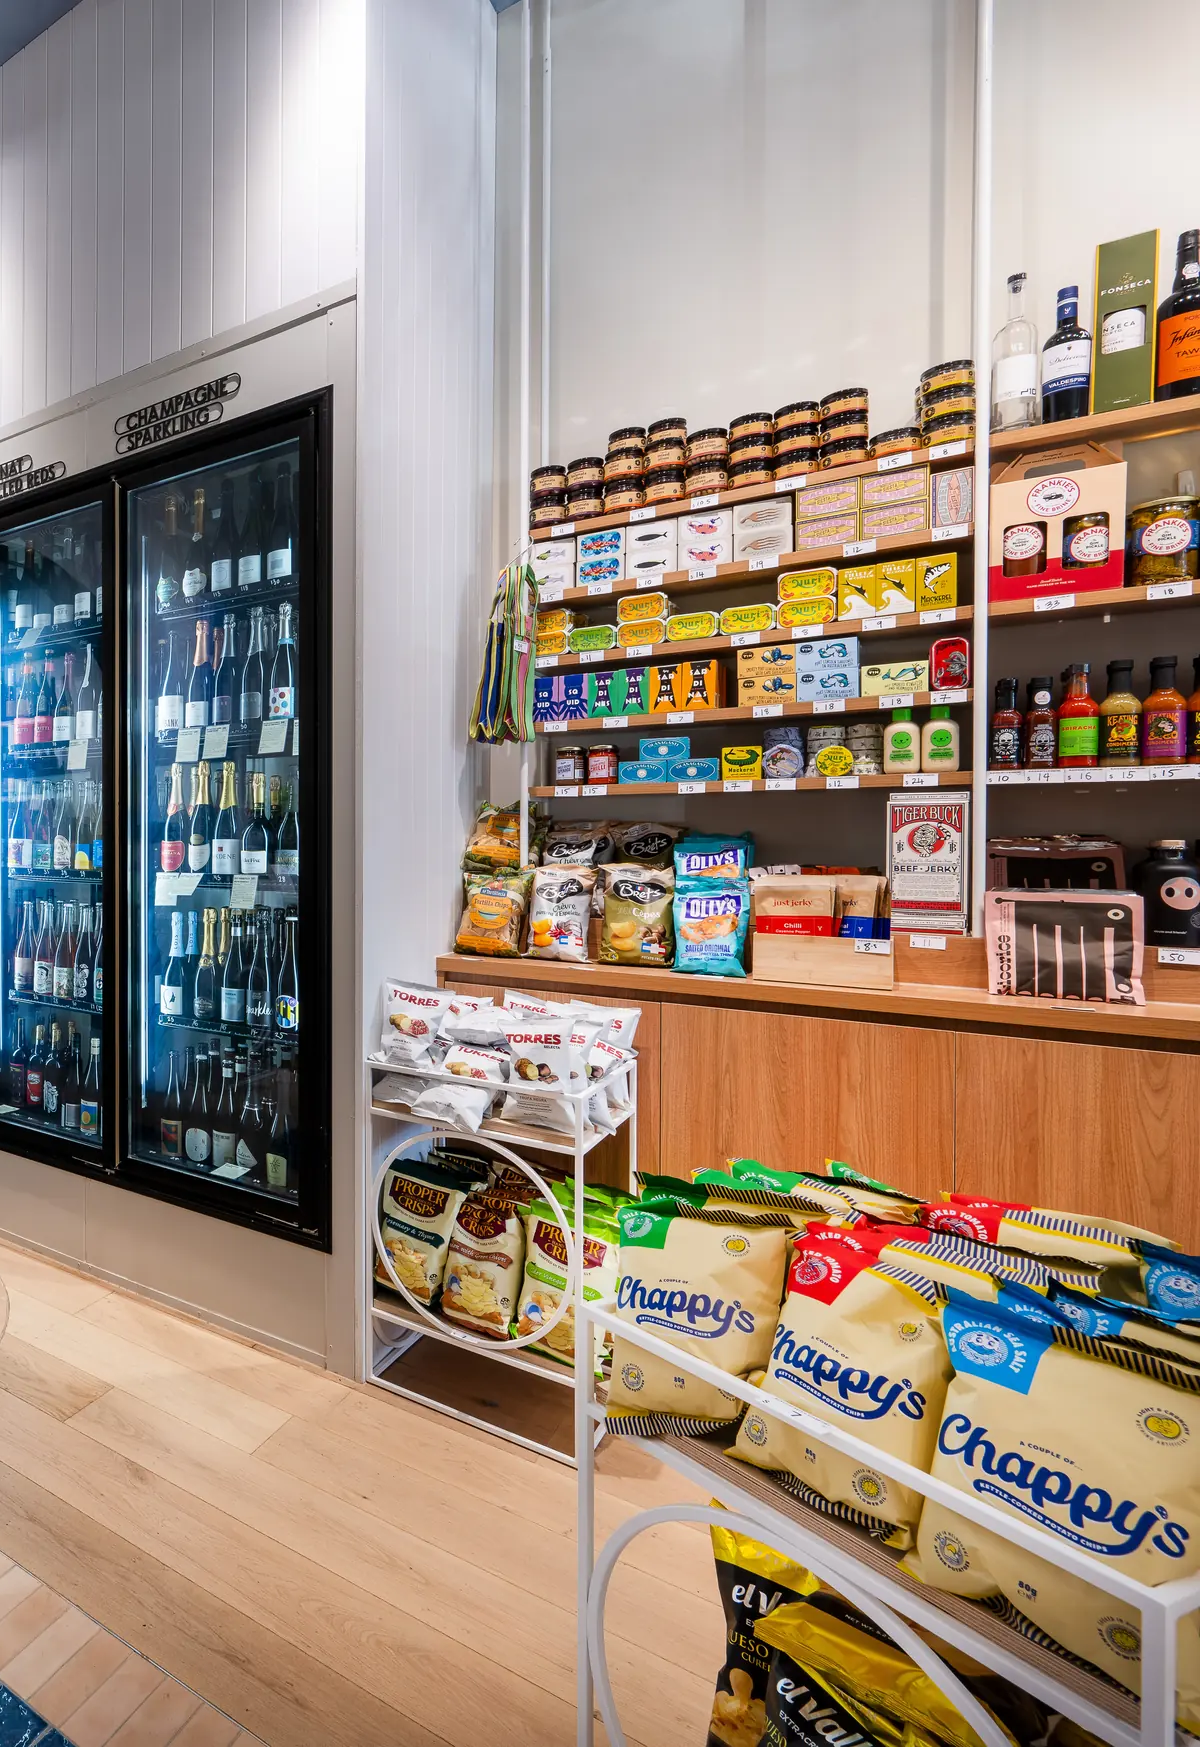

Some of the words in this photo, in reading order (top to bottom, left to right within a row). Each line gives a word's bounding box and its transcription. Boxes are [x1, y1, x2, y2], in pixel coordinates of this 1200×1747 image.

[1101, 279, 1151, 296] FONSECA
[1048, 376, 1087, 389] VALDESPINO
[126, 376, 228, 430] CHAMPAGNE
[127, 407, 209, 451] SPARKLING
[887, 458, 899, 466] 15
[0, 459, 25, 481] NAT
[27, 465, 56, 488] REDS
[1031, 479, 1076, 497] FRANKIE'S
[637, 510, 645, 518] 12
[941, 529, 953, 537] 12
[1145, 520, 1188, 537] FRANKIE'S
[852, 545, 863, 553] 12
[1148, 542, 1164, 550] FINE
[1165, 538, 1185, 550] BRINE
[756, 560, 764, 569] 19
[792, 576, 823, 589] Nuri
[546, 593, 555, 601] 15
[732, 611, 760, 623] Nuri
[792, 604, 821, 617] Nuri
[936, 613, 942, 621] 9
[678, 619, 705, 631] Nuri
[877, 621, 882, 629] 9
[891, 698, 901, 706] 18
[761, 708, 769, 716] 18
[1147, 712, 1180, 725] KEATING
[1107, 714, 1138, 727] KEATING
[1081, 772, 1092, 781] 16
[1122, 771, 1136, 779] 15
[1162, 769, 1183, 777] 15
[911, 777, 924, 785] 24
[894, 806, 928, 827] TIGER
[929, 805, 961, 828] BUCK
[925, 865, 958, 873] JERKY
[619, 883, 660, 900] Brets
[474, 899, 494, 907] Tortilla
[494, 901, 509, 909] Chips
[689, 897, 737, 918] OLLY'S
[773, 899, 790, 907] just
[790, 899, 812, 907] jerky
[632, 908, 660, 919] Cèpes
[685, 945, 703, 953] SALTED
[704, 945, 730, 953] ORIGINAL
[1169, 953, 1185, 962] 50
[393, 989, 440, 1007] TORRES
[505, 1033, 562, 1046] TORRES
[739, 1172, 756, 1182] DILL
[757, 1174, 782, 1188] PICKLE
[395, 1178, 445, 1207] PROPER
[398, 1195, 435, 1216] CRISPS
[622, 1211, 638, 1219] DILL
[639, 1211, 662, 1222] PICKLE
[462, 1217, 495, 1236] CRISPS
[927, 1209, 957, 1229] SMOKED
[960, 1211, 988, 1244] TOMATO
[417, 1231, 435, 1241] Thyme
[823, 1255, 842, 1283] TOMATO
[617, 1275, 755, 1339] Chappy's
[638, 1315, 673, 1328] KETTLE-COOKED
[673, 1323, 694, 1334] POTATO
[948, 1320, 1003, 1352] AUSTRALIAN
[1003, 1331, 1024, 1348] SEA
[815, 1336, 839, 1353] COUPLE
[1008, 1350, 1027, 1373] SALT
[778, 1370, 822, 1397] KETTLE-COOKED
[822, 1393, 845, 1411] POTATO
[845, 1407, 865, 1418] CHIPS
[1136, 1407, 1154, 1418] LIGHT
[1164, 1409, 1191, 1437] CRUNCHY
[1027, 1443, 1061, 1461] COUPLE
[937, 1413, 1190, 1558] Chappy's
[979, 1482, 1044, 1522] KETTLE-COOKED
[1044, 1519, 1078, 1543] POTATO
[1080, 1537, 1108, 1553] CHIPS
[1018, 1580, 1038, 1597] 80g
[731, 1583, 755, 1609] el
[844, 1613, 859, 1624] NET
[776, 1676, 802, 1704] el
